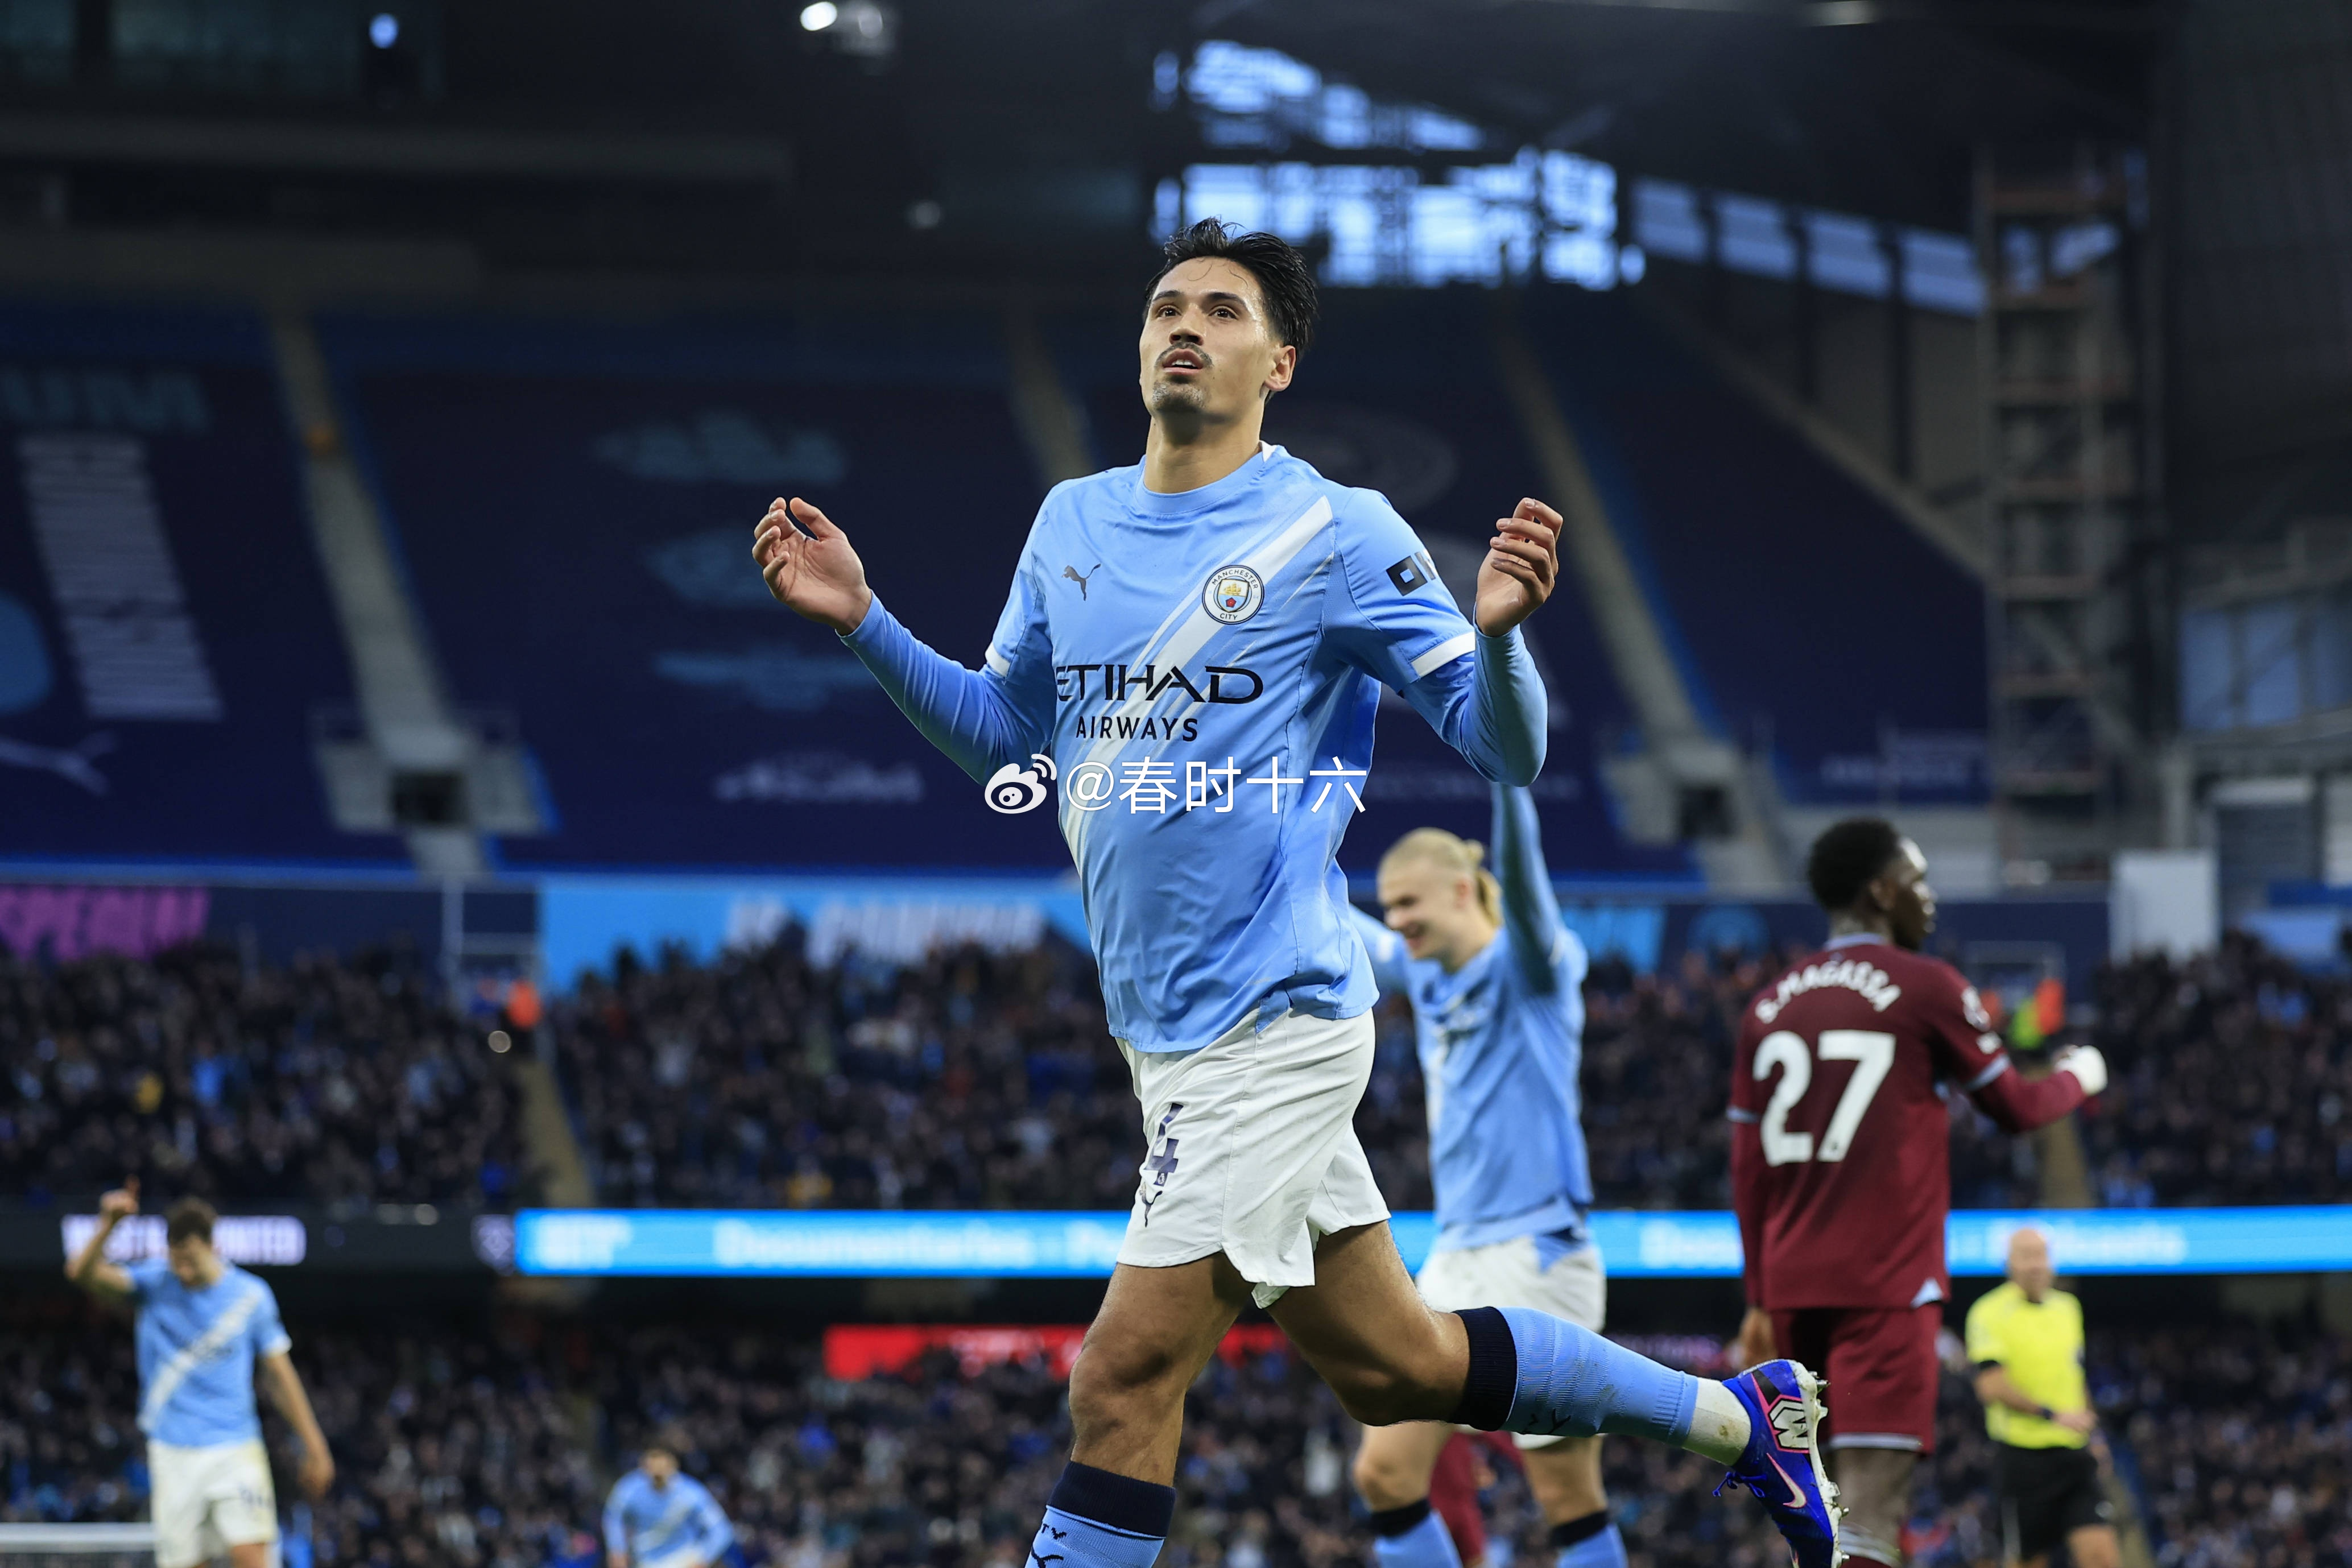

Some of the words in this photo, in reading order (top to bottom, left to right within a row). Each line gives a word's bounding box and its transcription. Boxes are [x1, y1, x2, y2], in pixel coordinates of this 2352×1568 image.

[1212, 569, 1259, 589] MANCHESTER
[1056, 664, 1263, 704] ETIHAD
[1076, 716, 1198, 742] AIRWAYS
[1752, 1030, 1896, 1166] 27
[1144, 1102, 1184, 1187] 4
